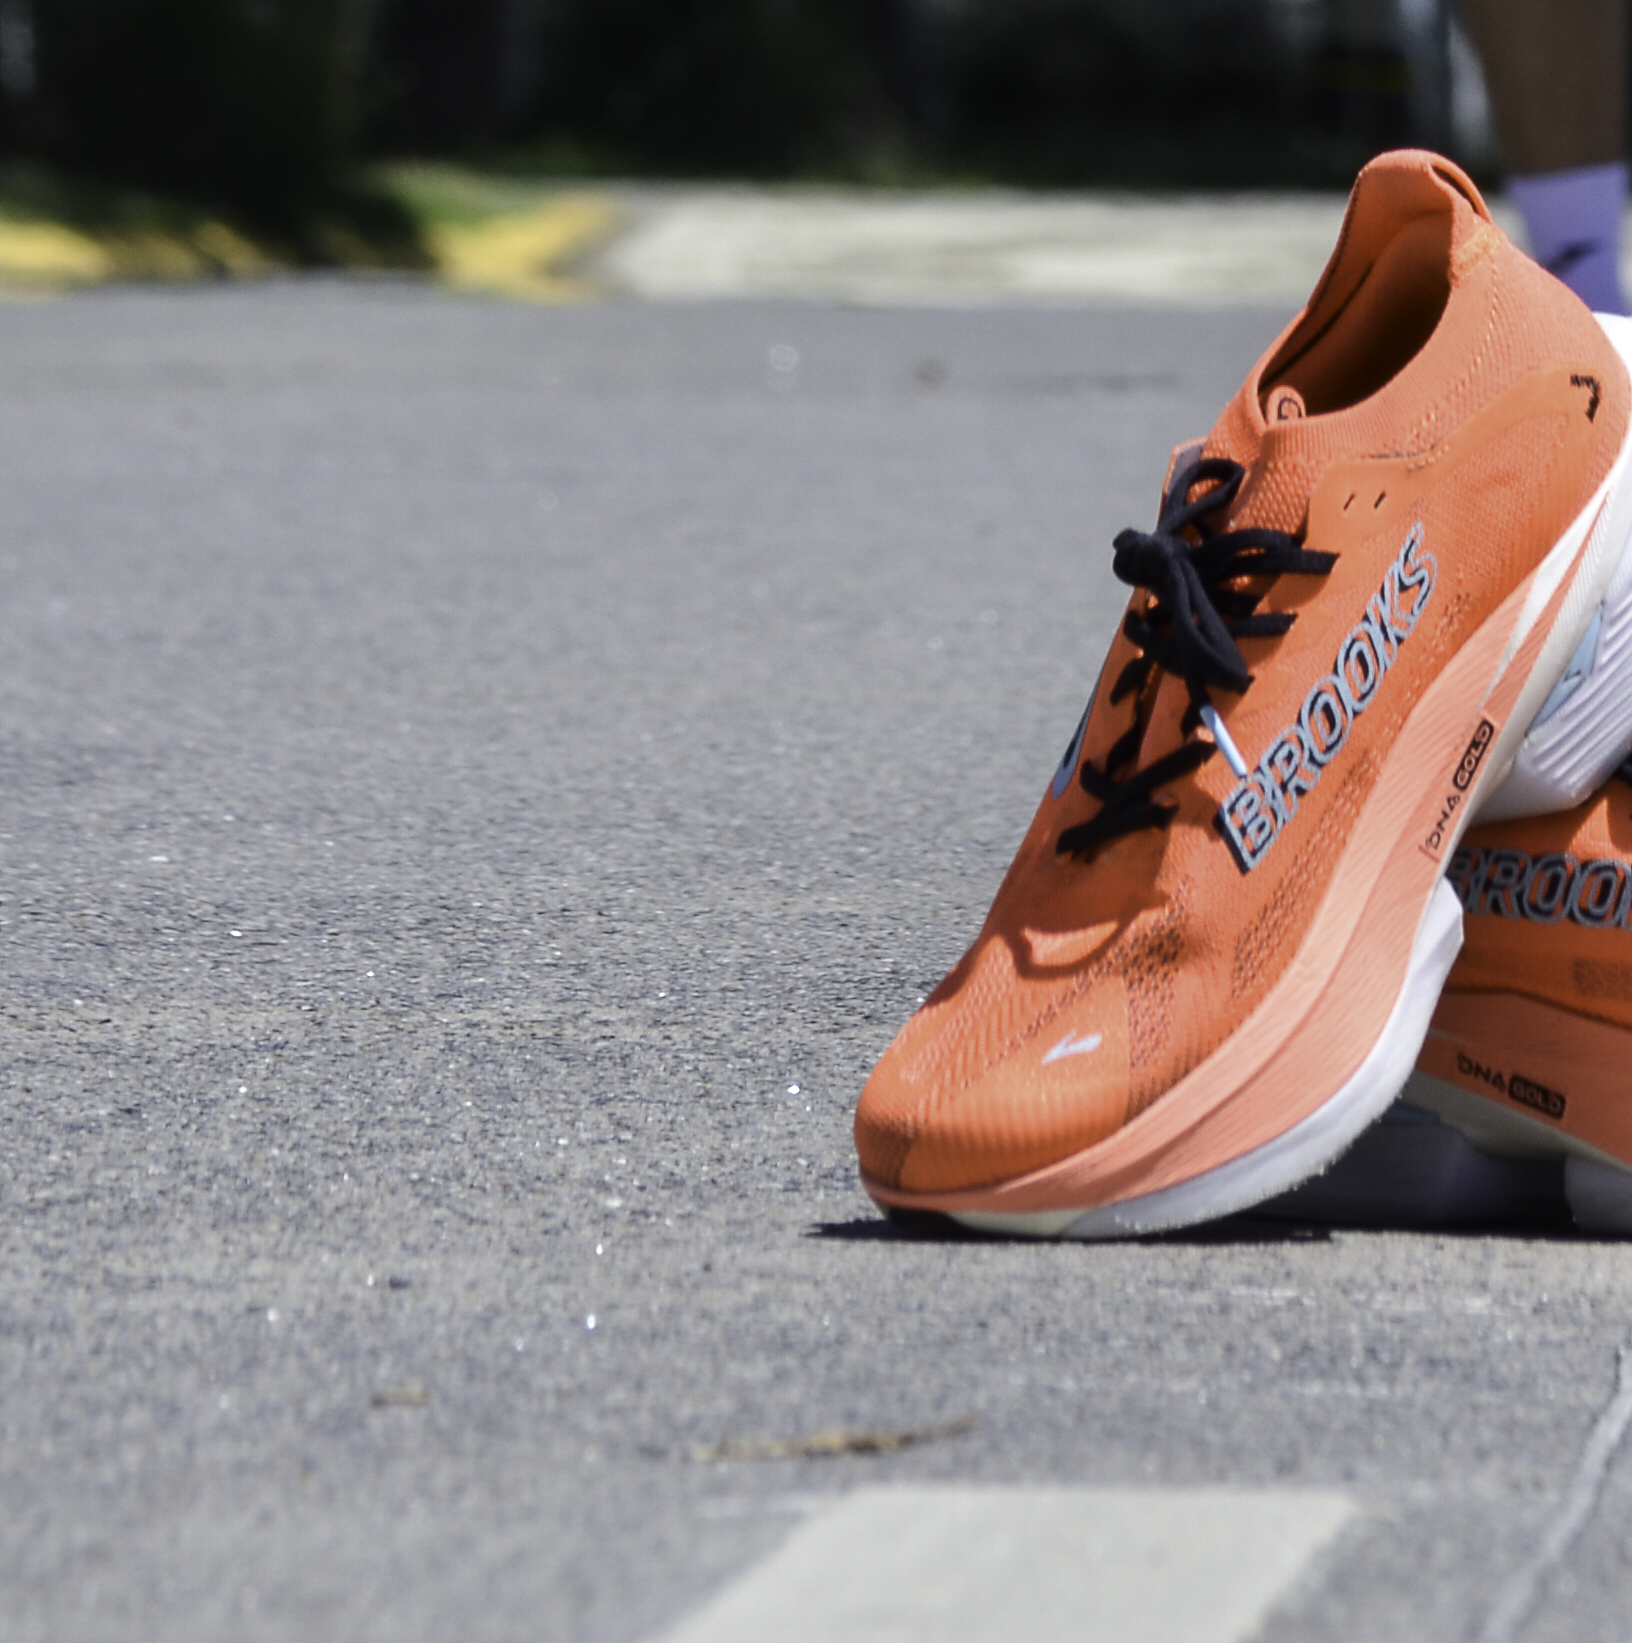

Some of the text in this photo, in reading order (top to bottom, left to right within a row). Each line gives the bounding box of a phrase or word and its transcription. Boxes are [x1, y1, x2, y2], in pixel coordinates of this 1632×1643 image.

[1216, 520, 1438, 875] BROOKS
[1426, 722, 1492, 849] DNA GOLD
